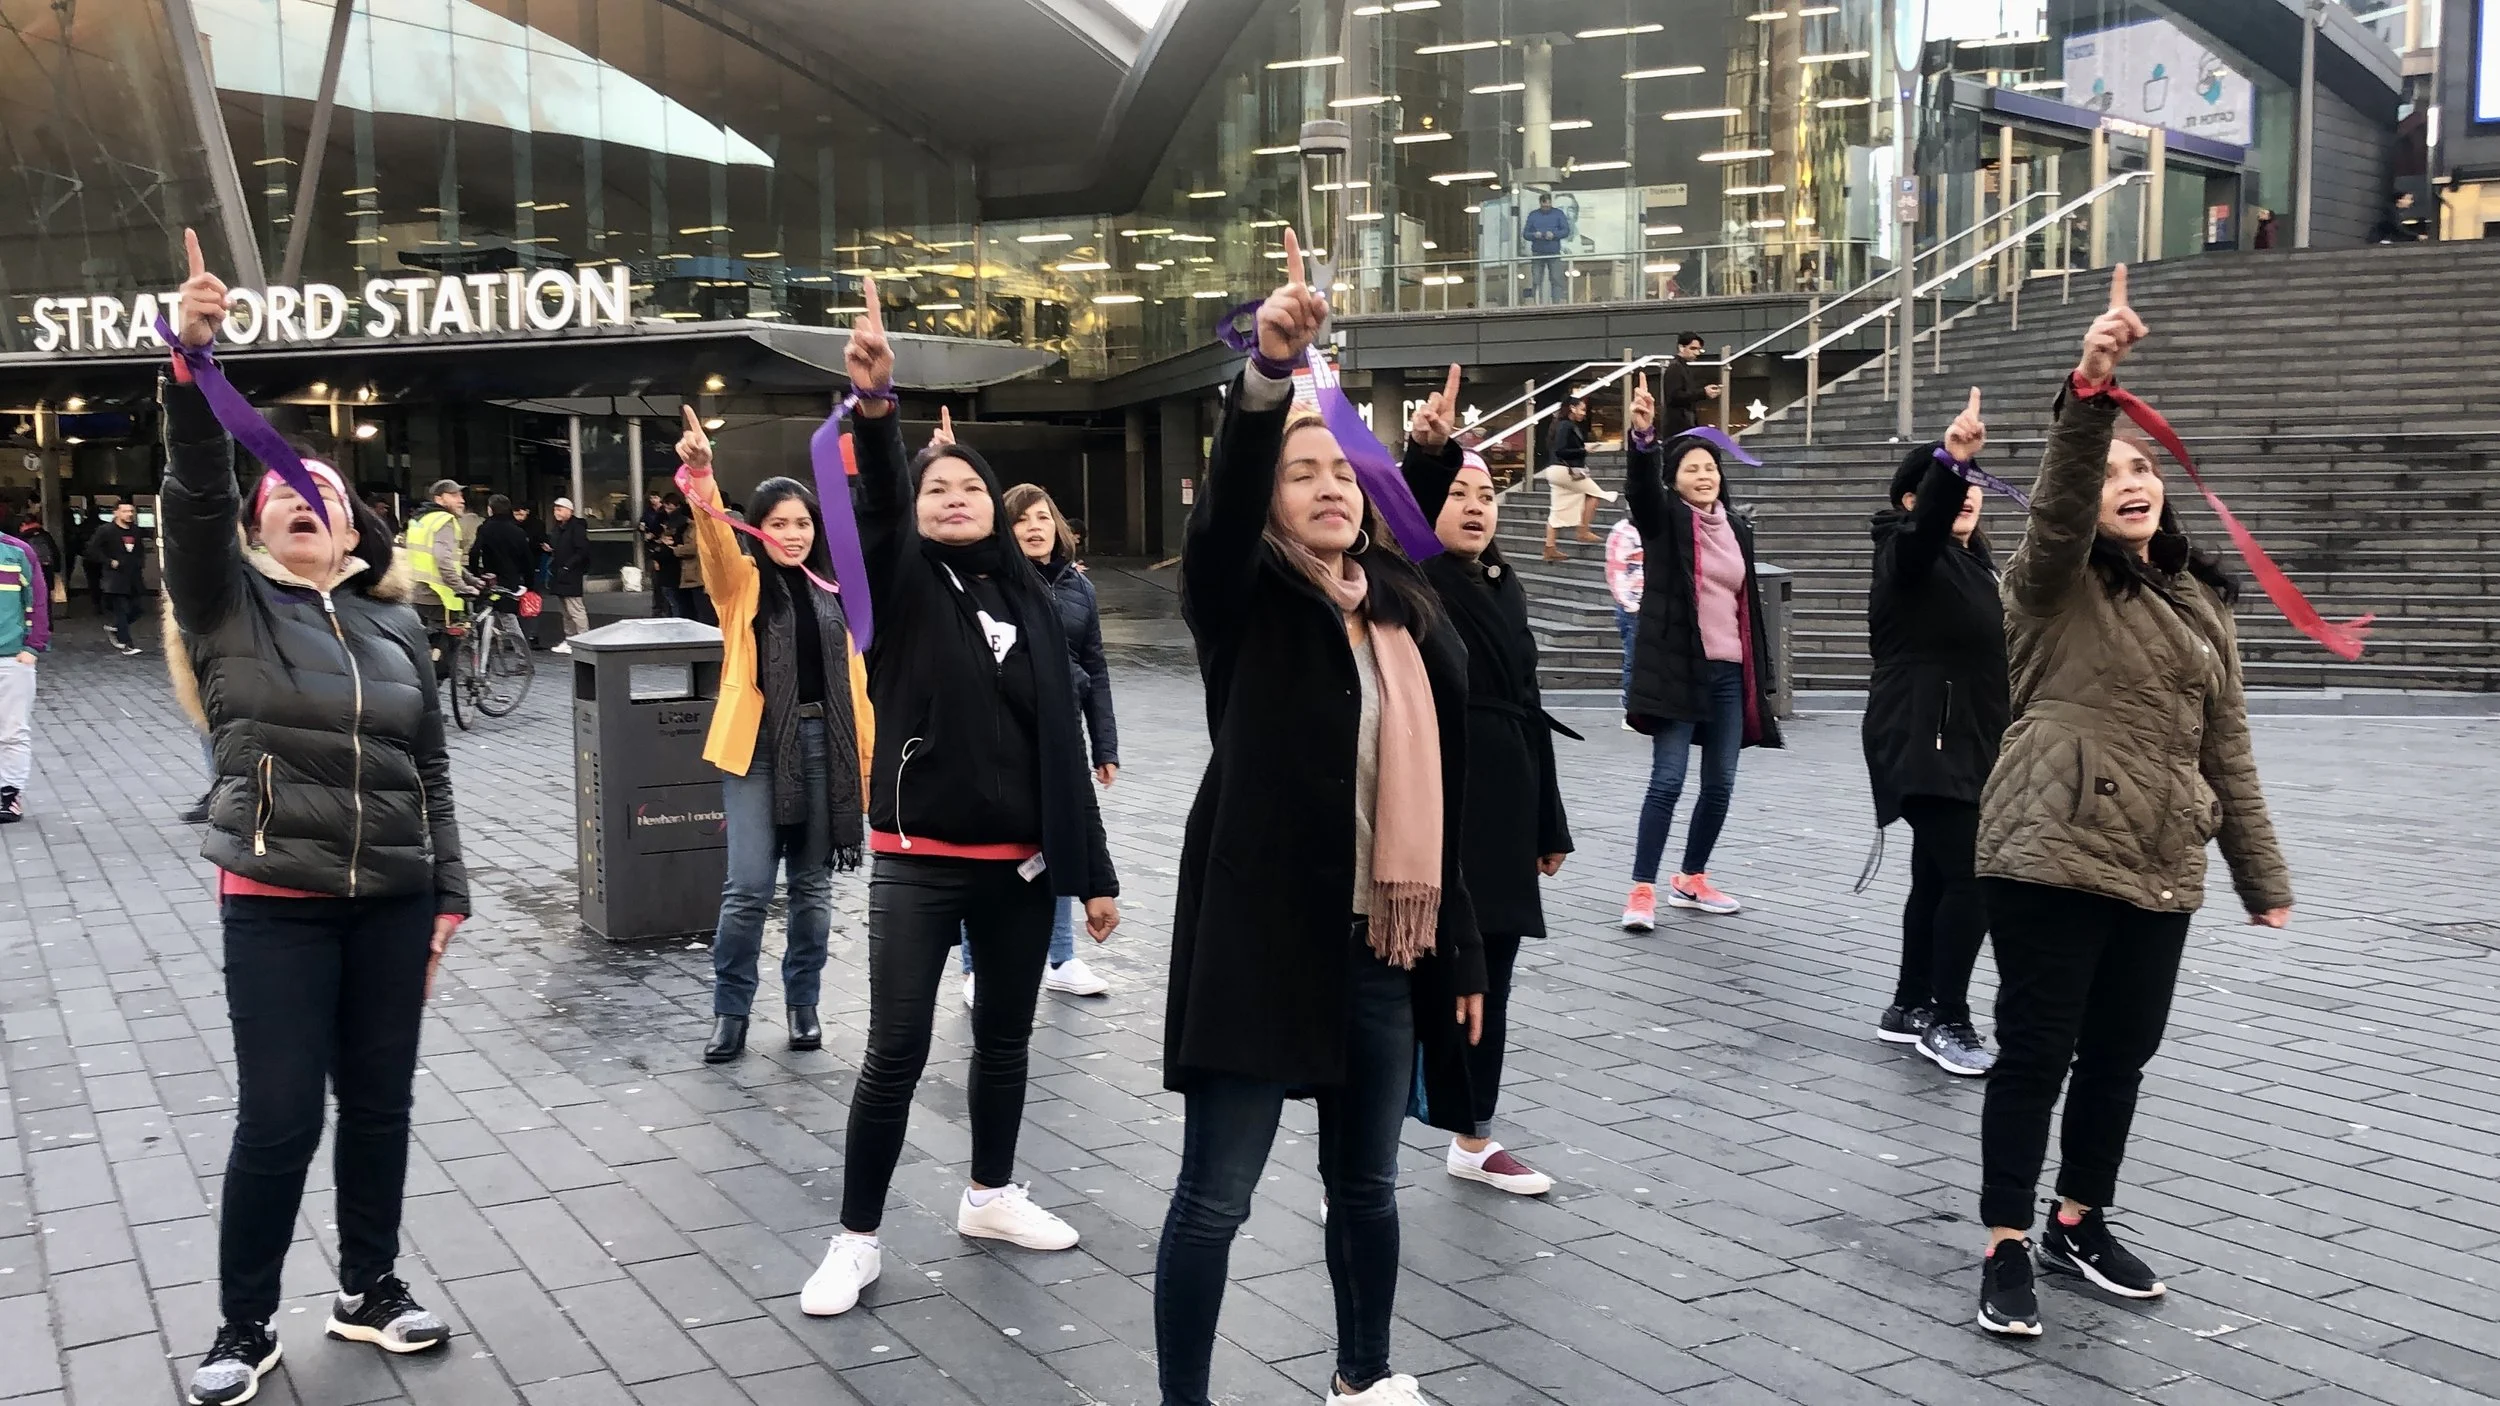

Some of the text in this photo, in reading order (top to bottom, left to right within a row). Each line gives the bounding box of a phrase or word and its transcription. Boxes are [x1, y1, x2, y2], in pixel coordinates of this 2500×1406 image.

[33, 266, 632, 351] STRATORD STATION
[658, 711, 700, 724] Litter
[637, 814, 685, 826] Newham
